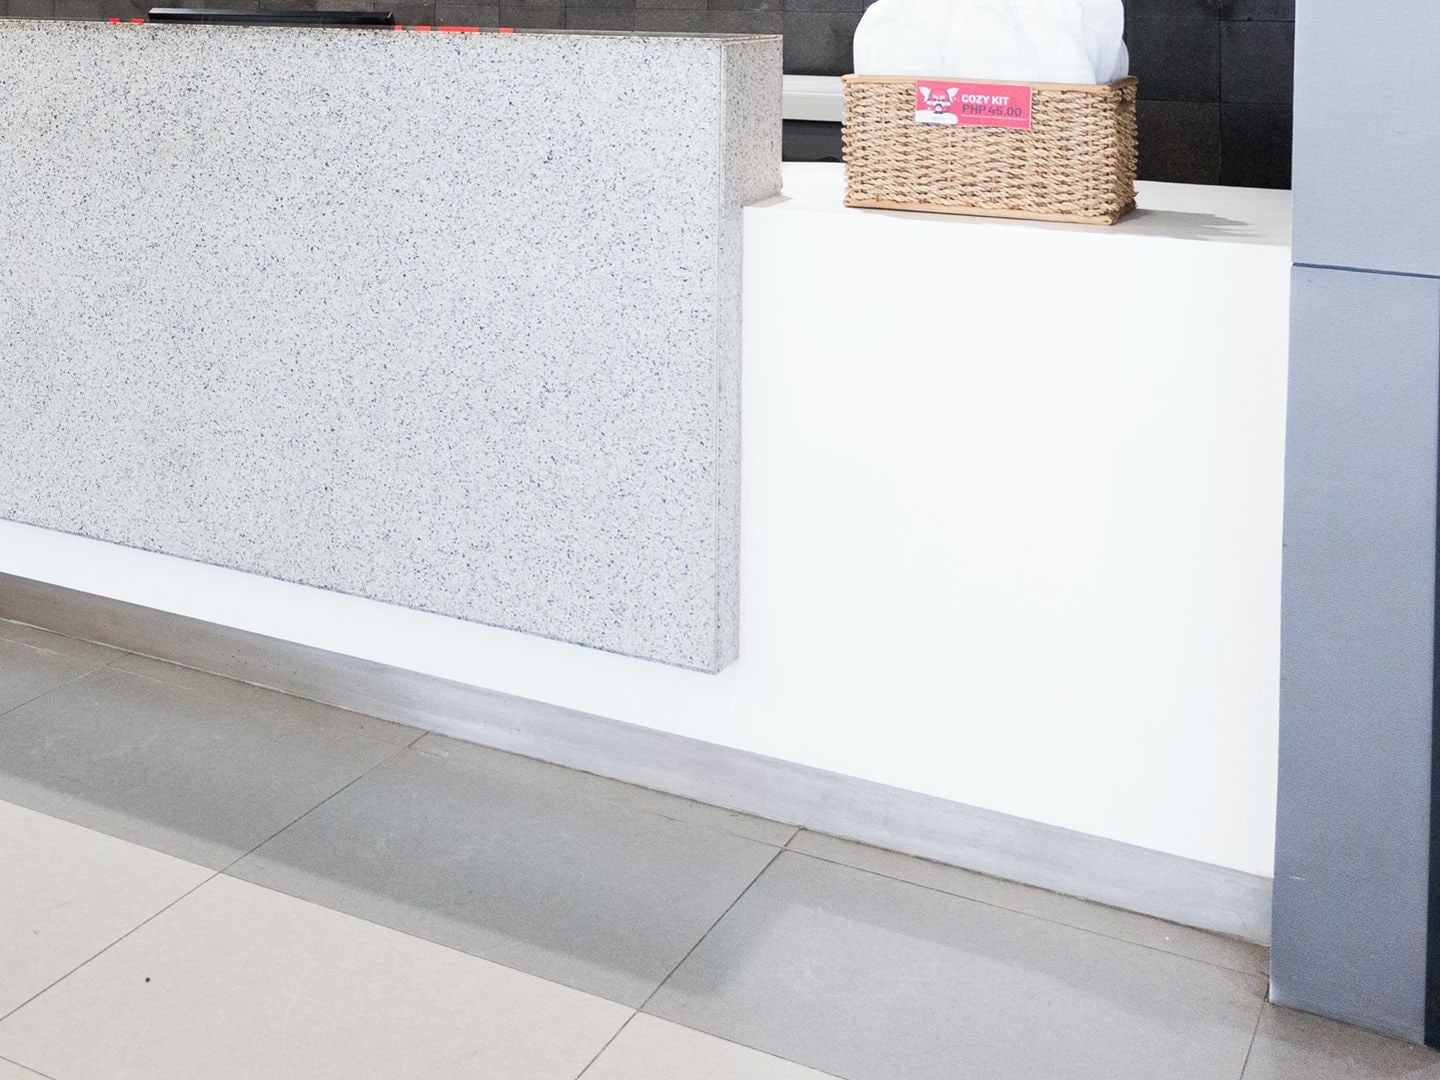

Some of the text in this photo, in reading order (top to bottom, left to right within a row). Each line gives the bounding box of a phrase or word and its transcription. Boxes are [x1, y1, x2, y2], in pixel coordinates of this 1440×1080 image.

[961, 94, 1009, 106] COZY KIT
[961, 104, 1022, 116] PHP 45.00
